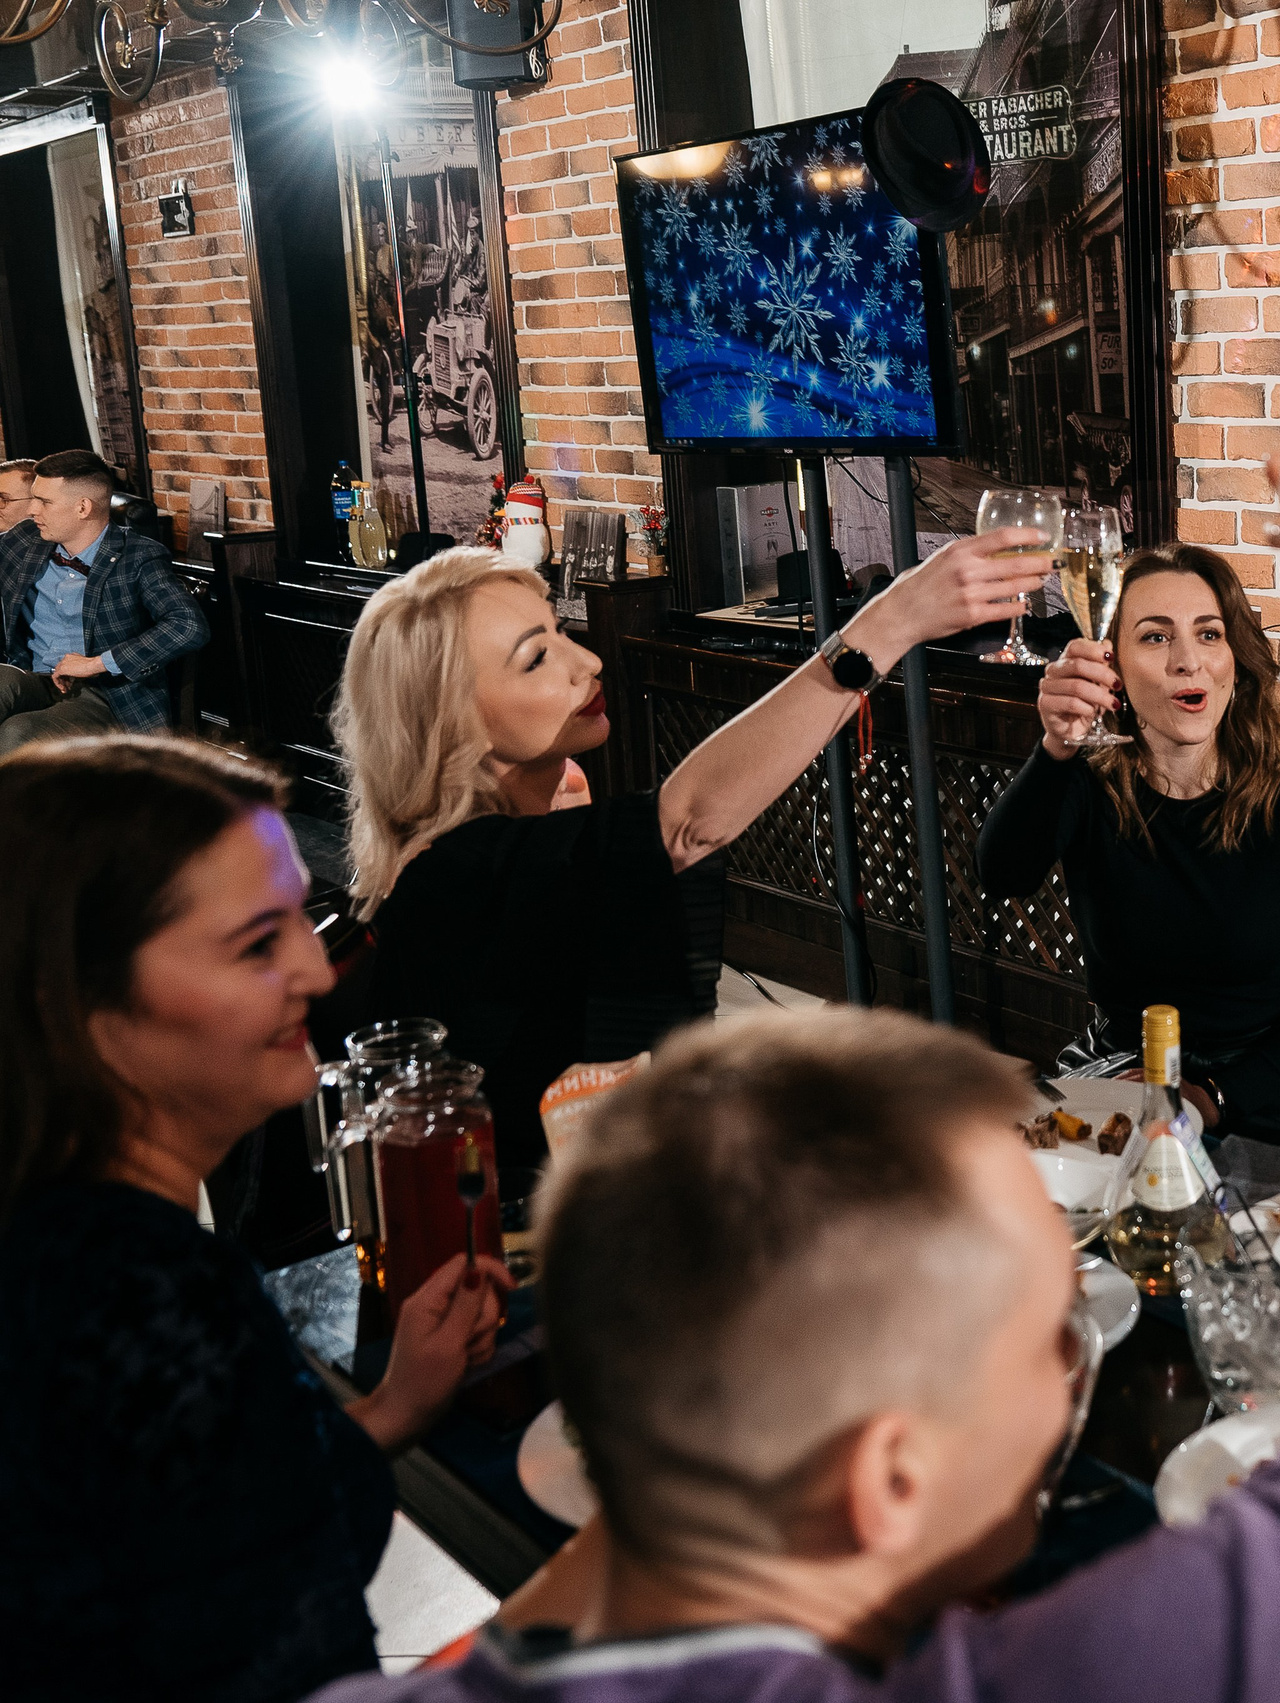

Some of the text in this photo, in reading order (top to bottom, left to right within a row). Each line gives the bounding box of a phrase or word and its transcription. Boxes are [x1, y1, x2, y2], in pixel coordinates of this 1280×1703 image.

[964, 90, 1063, 119] ER FABACHER
[979, 114, 1030, 133] & BROS.
